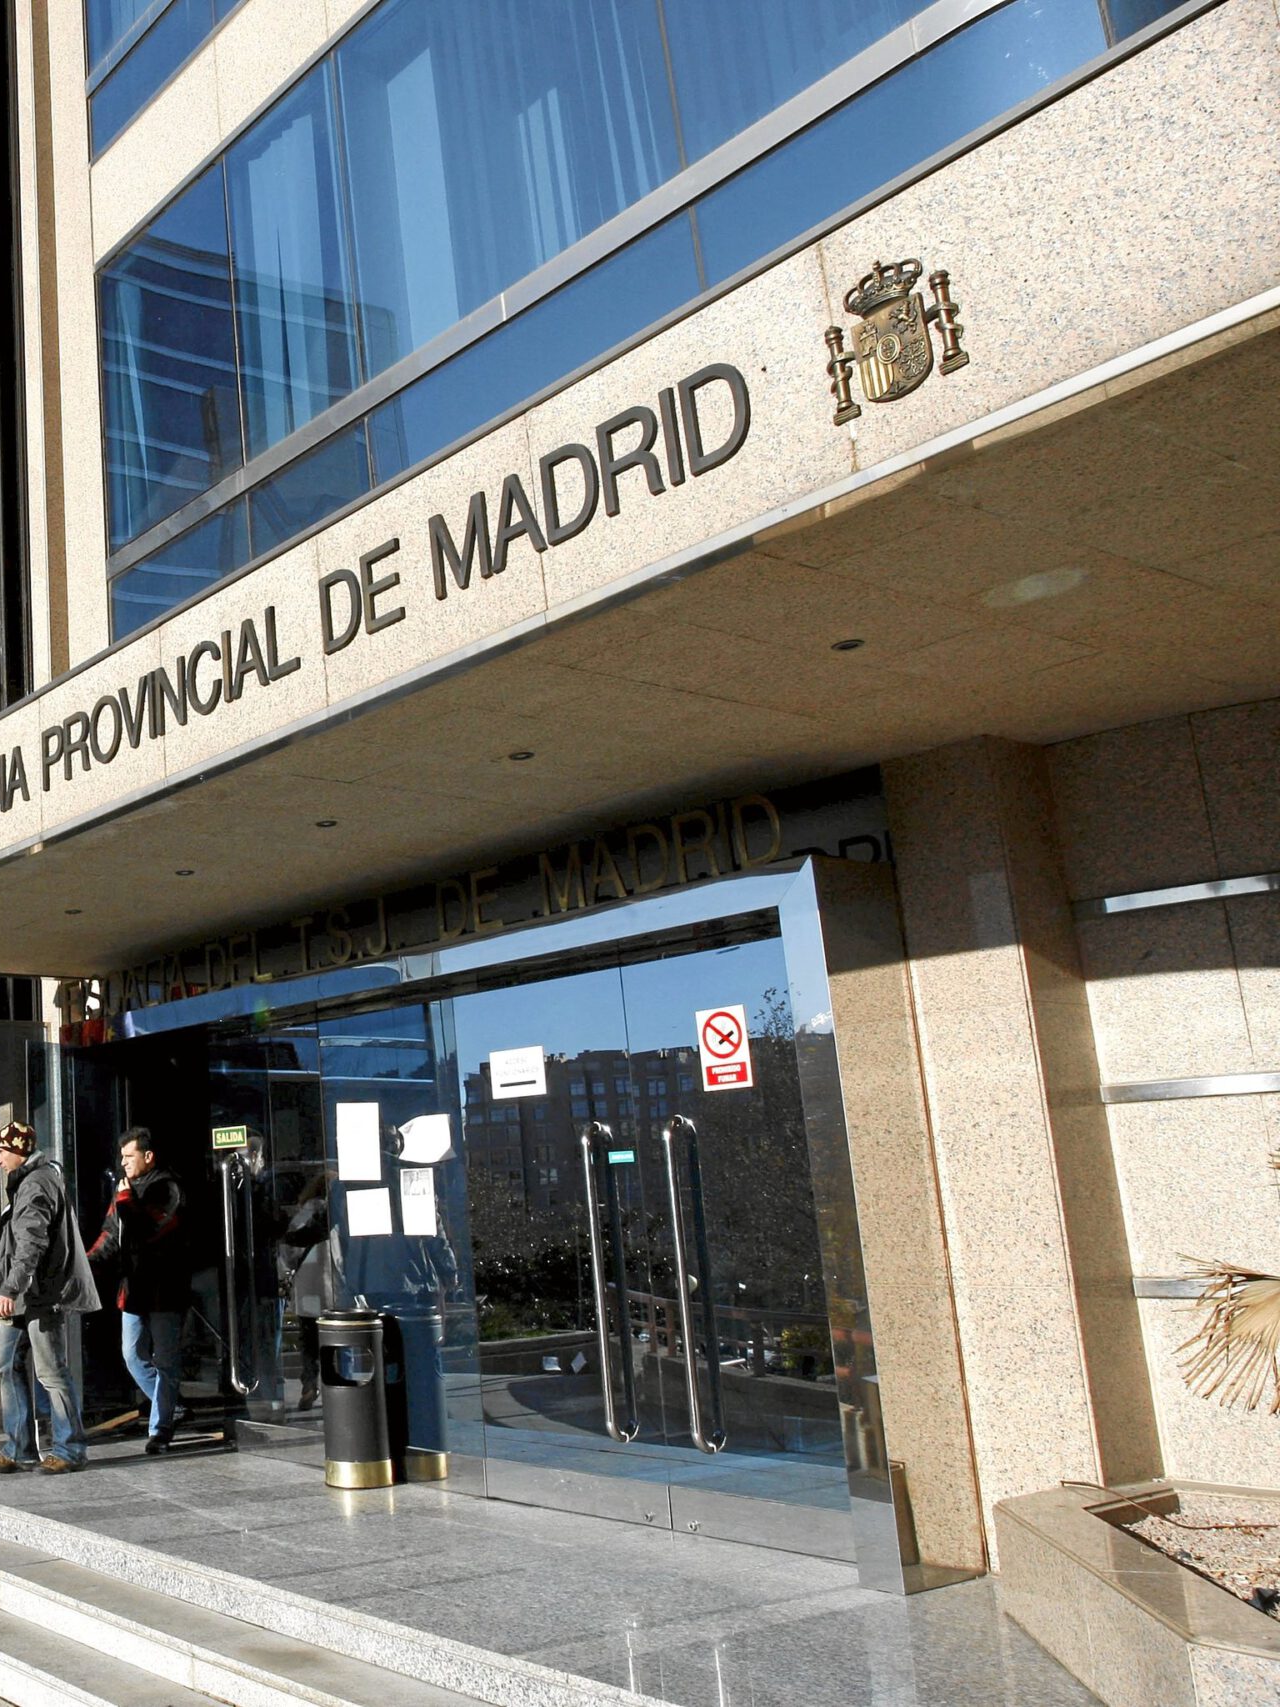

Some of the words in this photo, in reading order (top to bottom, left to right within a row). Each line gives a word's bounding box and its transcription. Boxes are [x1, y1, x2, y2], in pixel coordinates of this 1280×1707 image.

[41, 605, 301, 791] PROVINCIAL
[319, 537, 406, 655] DE
[427, 362, 751, 601] MADRID
[205, 930, 273, 989] DEL
[436, 865, 504, 940] DE
[538, 795, 782, 916] MADRID
[717, 1073, 737, 1083] FUMAR
[216, 1131, 244, 1144] SALIDA
